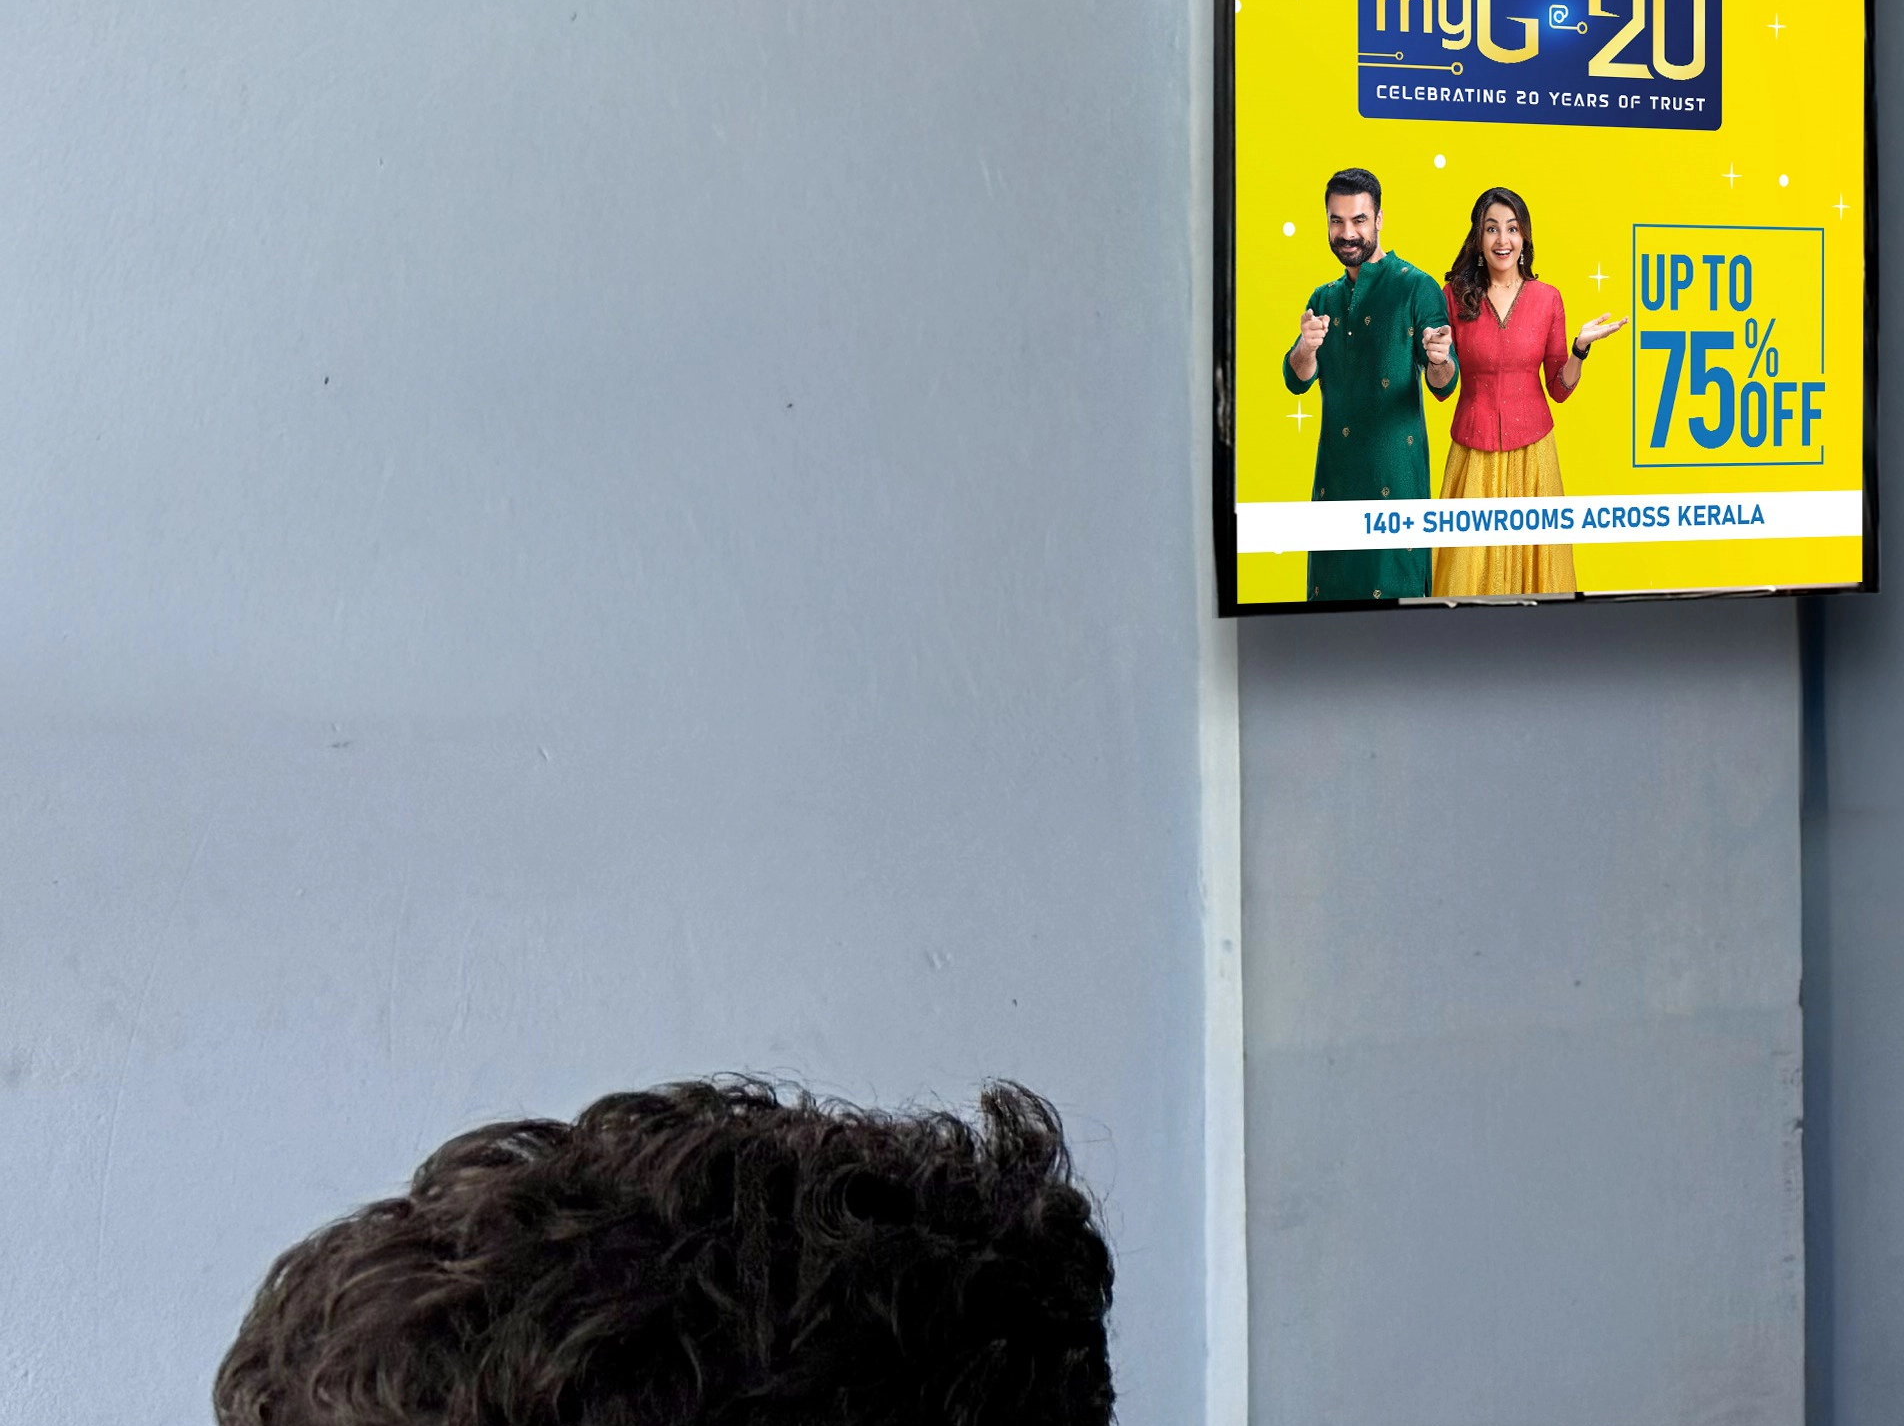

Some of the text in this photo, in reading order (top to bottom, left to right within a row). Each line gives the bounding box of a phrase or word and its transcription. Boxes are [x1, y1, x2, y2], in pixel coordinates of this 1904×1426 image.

[1376, 85, 1706, 112] CELEBRATING 20 YEARS OF TRUST
[1641, 254, 1752, 312] UP TO
[1740, 381, 1826, 447] OFF
[1364, 504, 1765, 535] 140+ SHOWROOMS ACROSS KERALA
